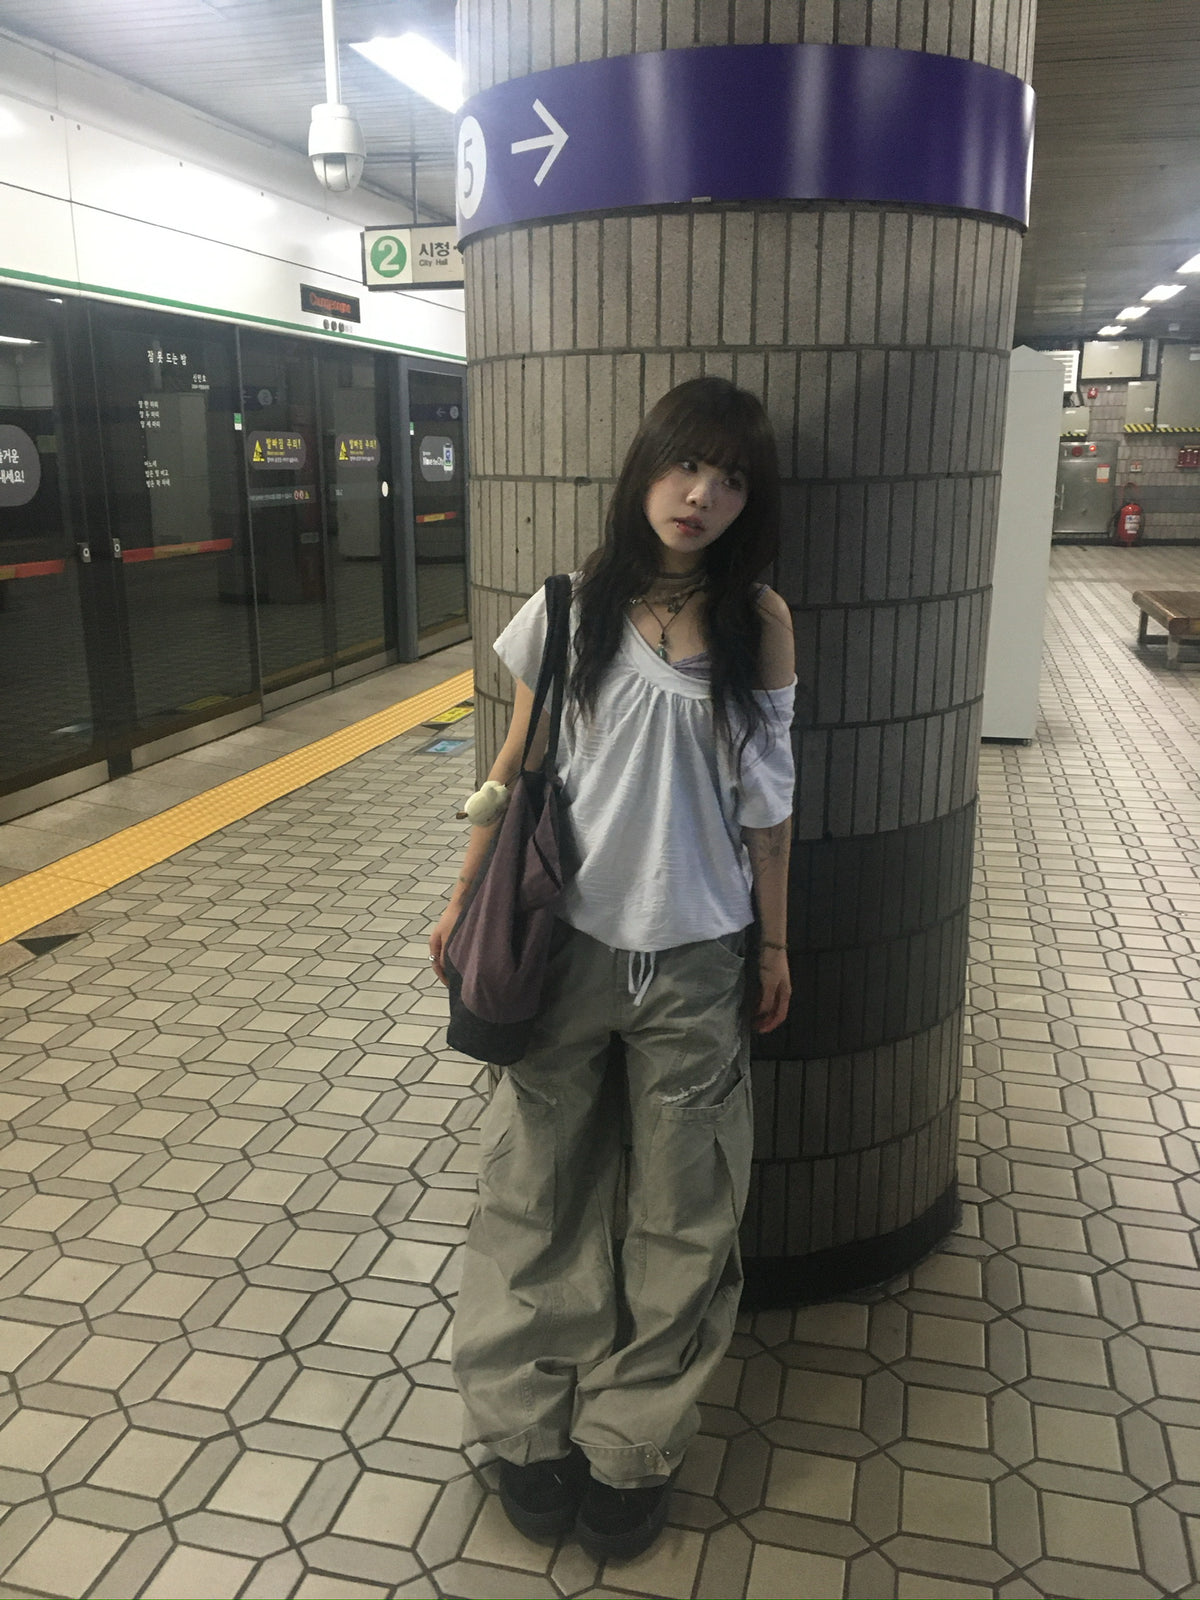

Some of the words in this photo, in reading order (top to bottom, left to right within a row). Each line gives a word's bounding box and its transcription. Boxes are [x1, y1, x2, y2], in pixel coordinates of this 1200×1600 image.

[463, 138, 474, 199] 5
[378, 239, 399, 271] 2
[419, 259, 432, 267] City
[435, 258, 449, 266] Hall
[157, 351, 163, 363] 못
[166, 352, 179, 365] 드는
[180, 353, 187, 366] 밤
